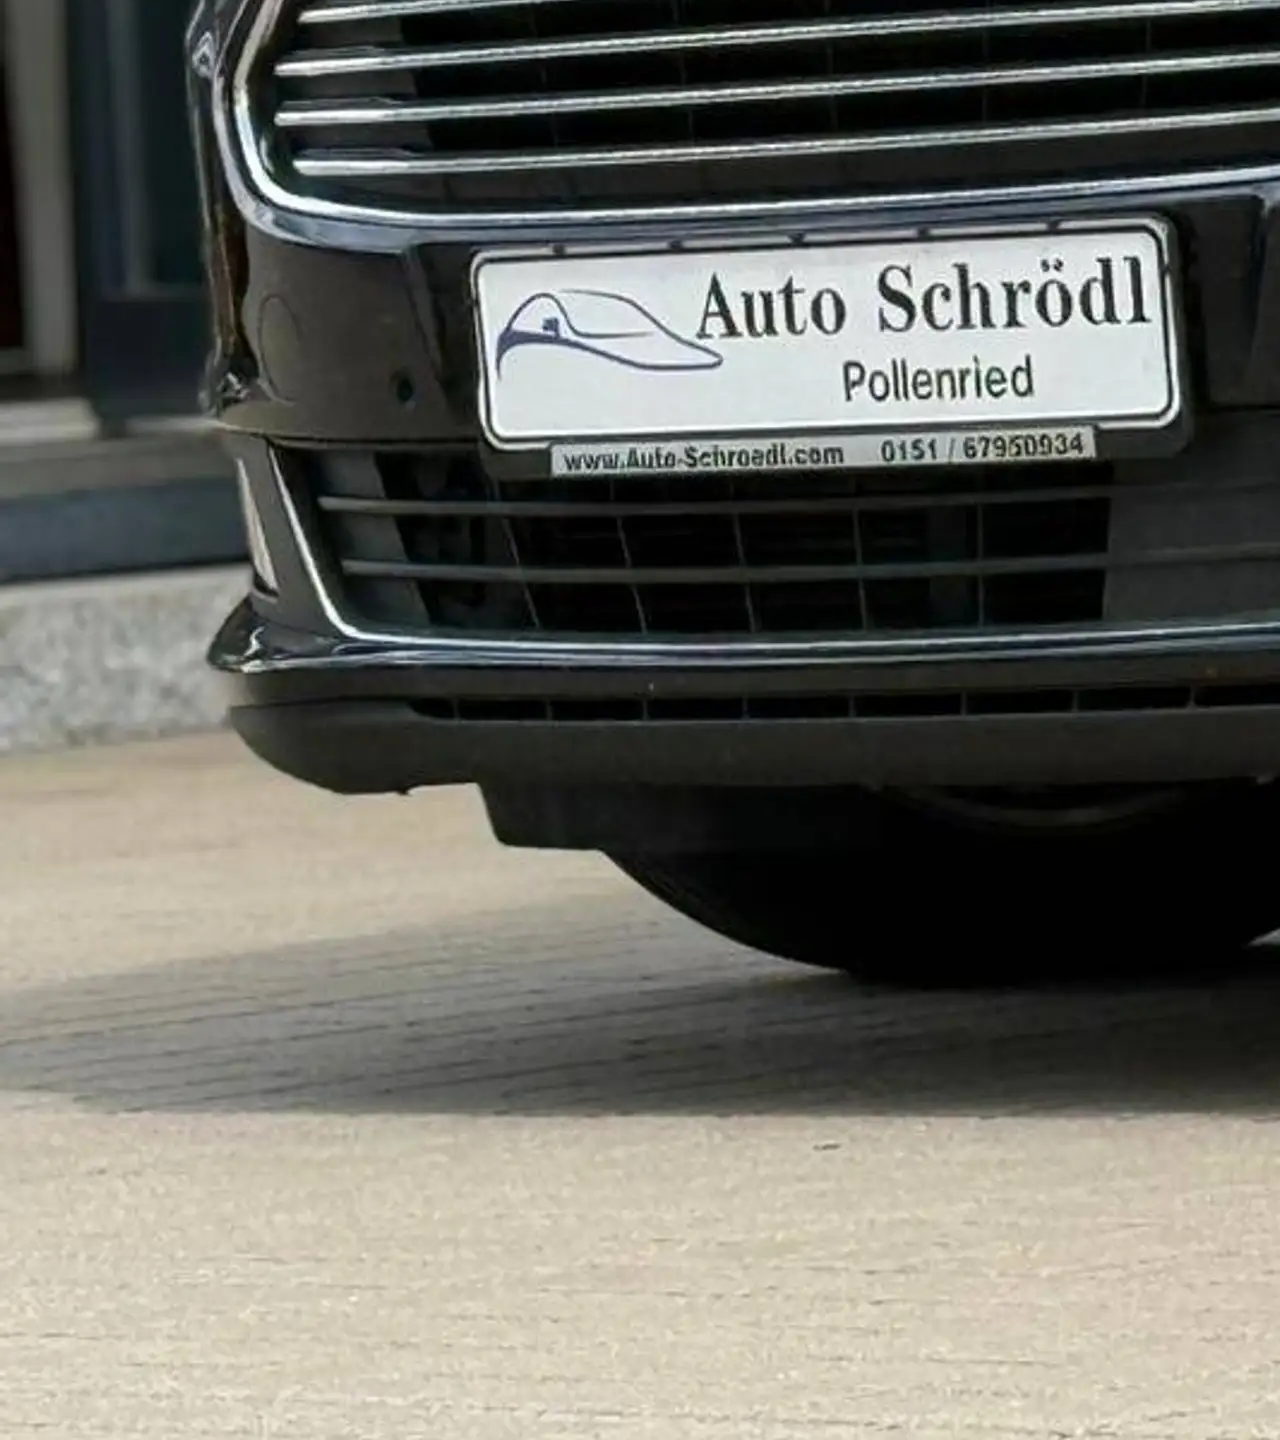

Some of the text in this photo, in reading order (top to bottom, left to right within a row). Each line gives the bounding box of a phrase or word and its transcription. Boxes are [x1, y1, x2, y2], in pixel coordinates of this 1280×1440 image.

[695, 256, 1152, 340] Auto Schrödl
[843, 355, 1035, 402] Pollenried
[880, 438, 937, 462] 0151
